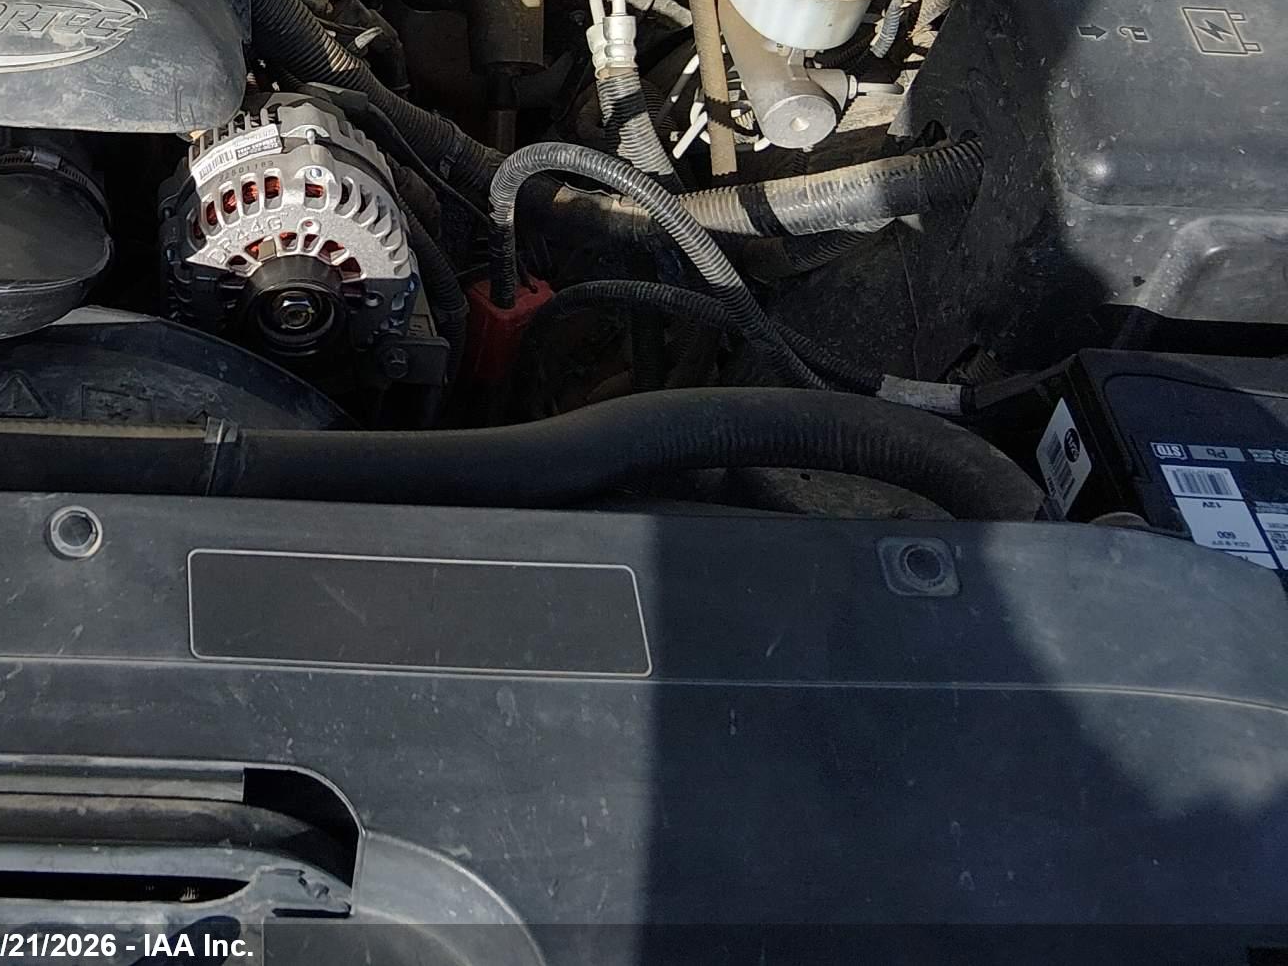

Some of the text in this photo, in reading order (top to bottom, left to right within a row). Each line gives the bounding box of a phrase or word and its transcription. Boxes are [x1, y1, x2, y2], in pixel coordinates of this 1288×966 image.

[1156, 444, 1181, 457] STD
[1206, 448, 1229, 459] Pb
[1202, 501, 1222, 509] 12V
